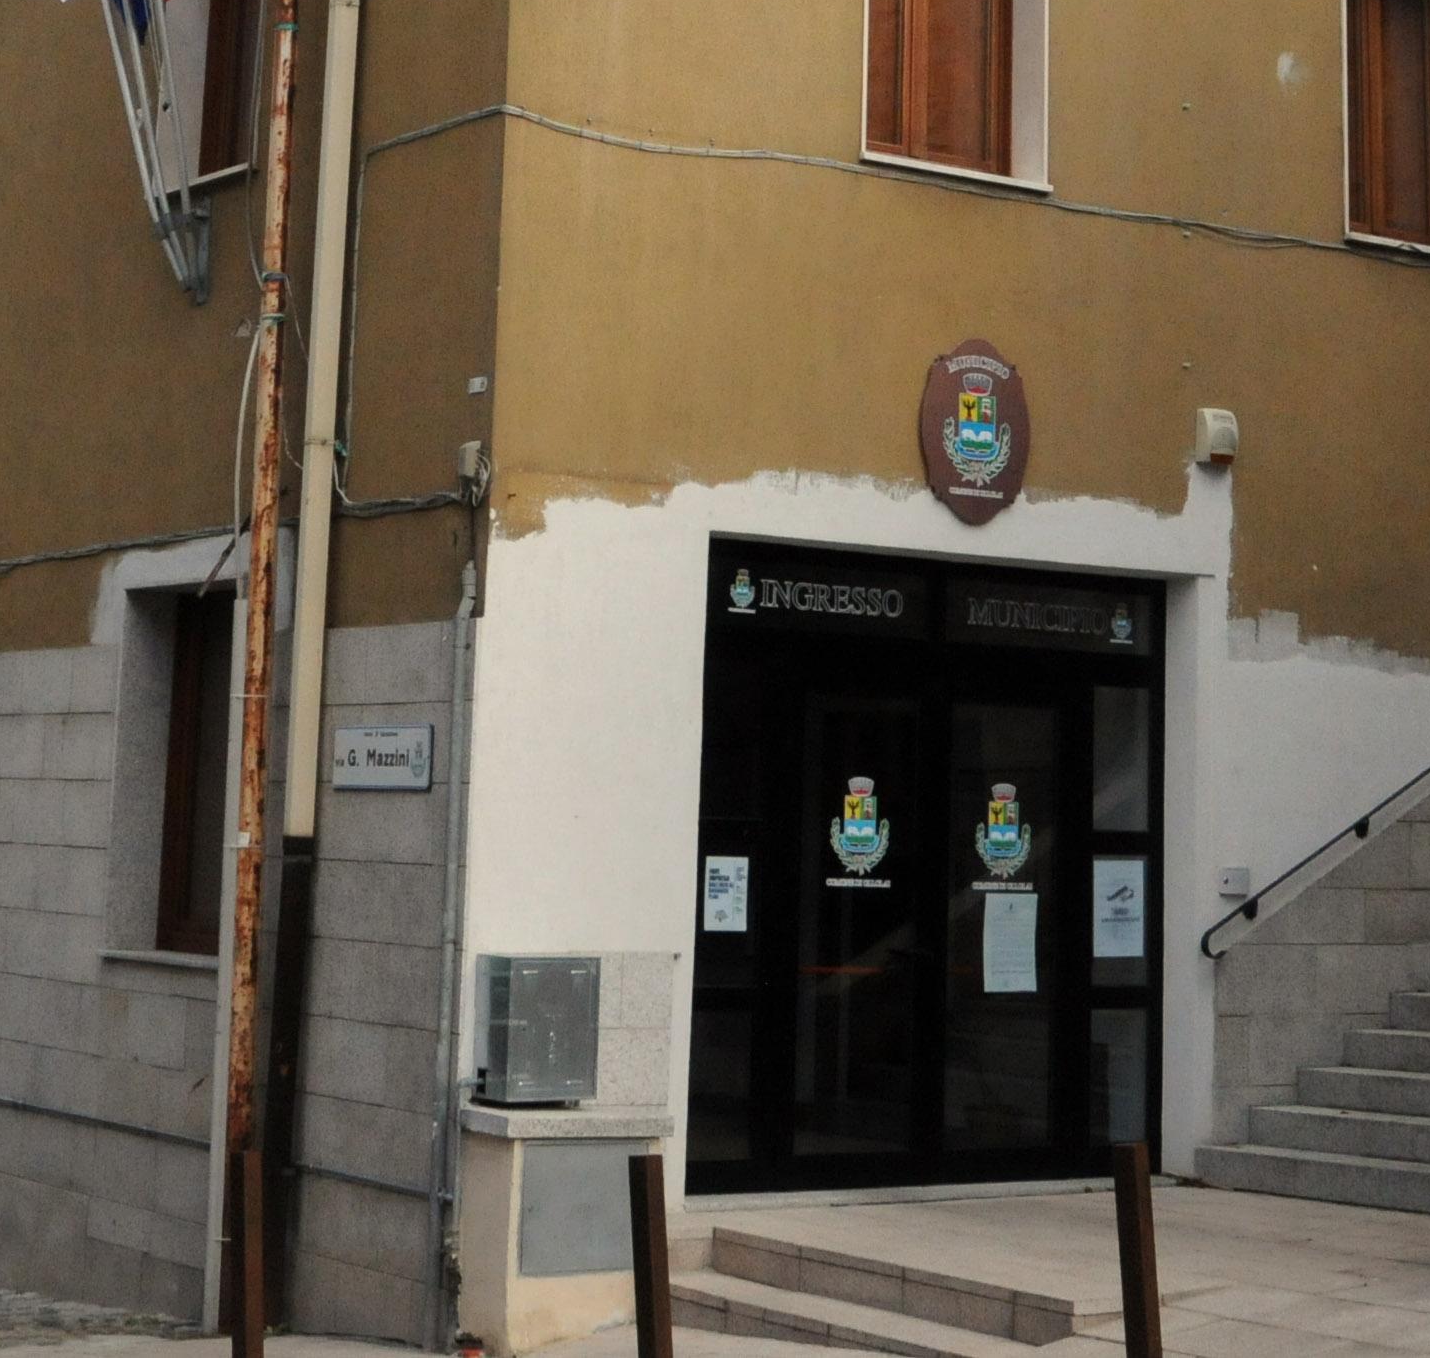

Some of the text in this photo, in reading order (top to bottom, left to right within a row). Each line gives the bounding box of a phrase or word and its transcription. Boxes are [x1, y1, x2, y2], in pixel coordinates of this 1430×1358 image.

[759, 578, 1108, 636] INGRESSO MUNICIPIO
[347, 748, 360, 767] G.
[366, 748, 410, 767] Mazzini
